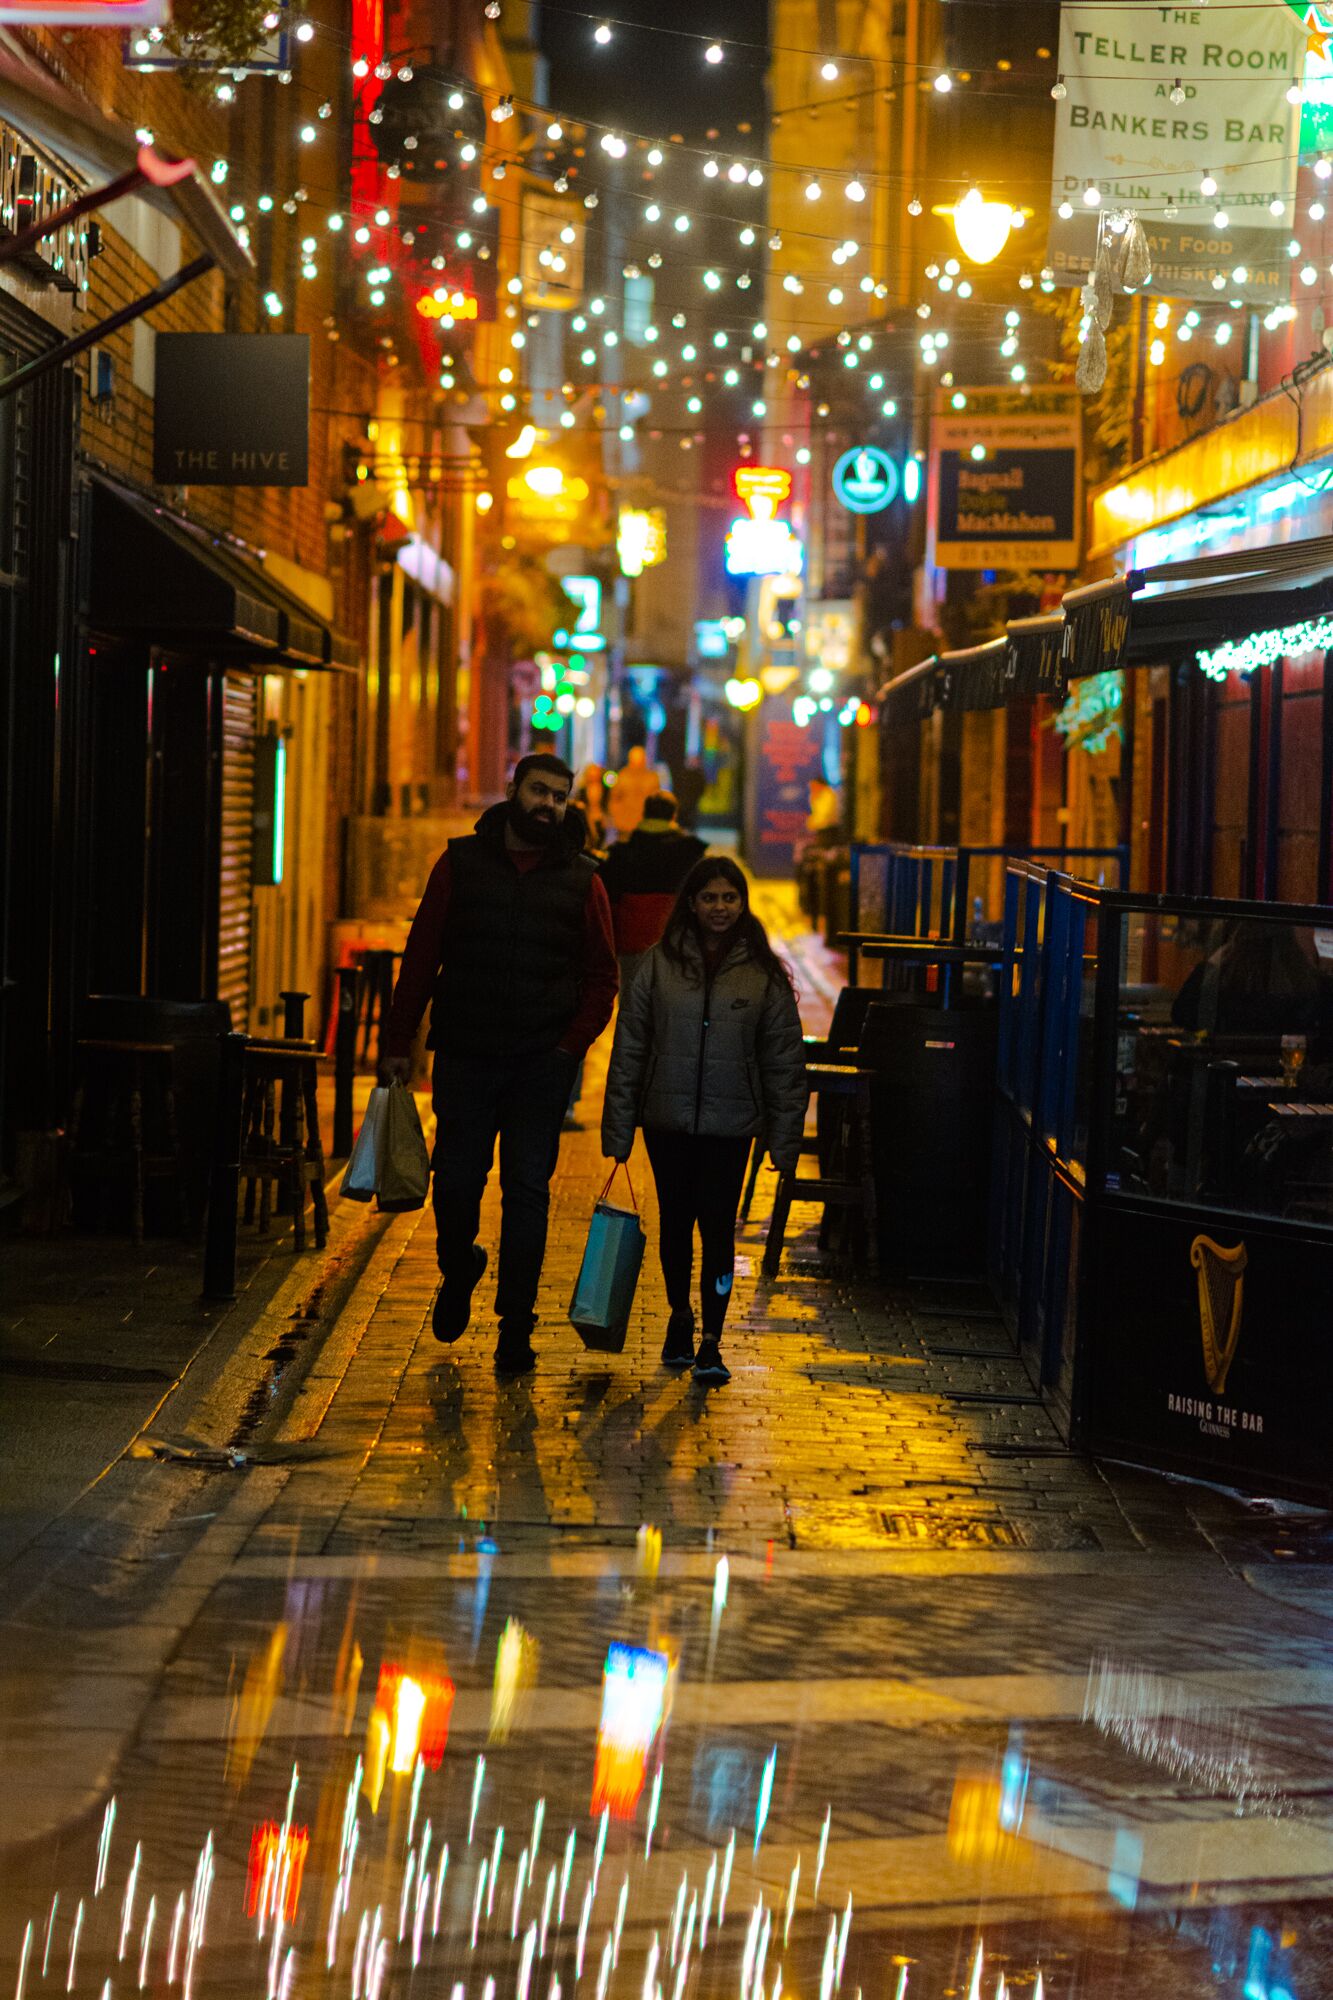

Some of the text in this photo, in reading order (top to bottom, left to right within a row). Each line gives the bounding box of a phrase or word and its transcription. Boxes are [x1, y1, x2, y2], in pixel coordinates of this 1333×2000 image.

[1158, 7, 1201, 25] THE
[1074, 32, 1288, 71] TELLER ROOM
[1070, 105, 1285, 144] BANKERS BAR
[1179, 236, 1234, 255] FOOD
[1053, 251, 1096, 272] BEE
[175, 451, 289, 471] THE HIVE
[1168, 1393, 1264, 1433] RAISING THE BAR
